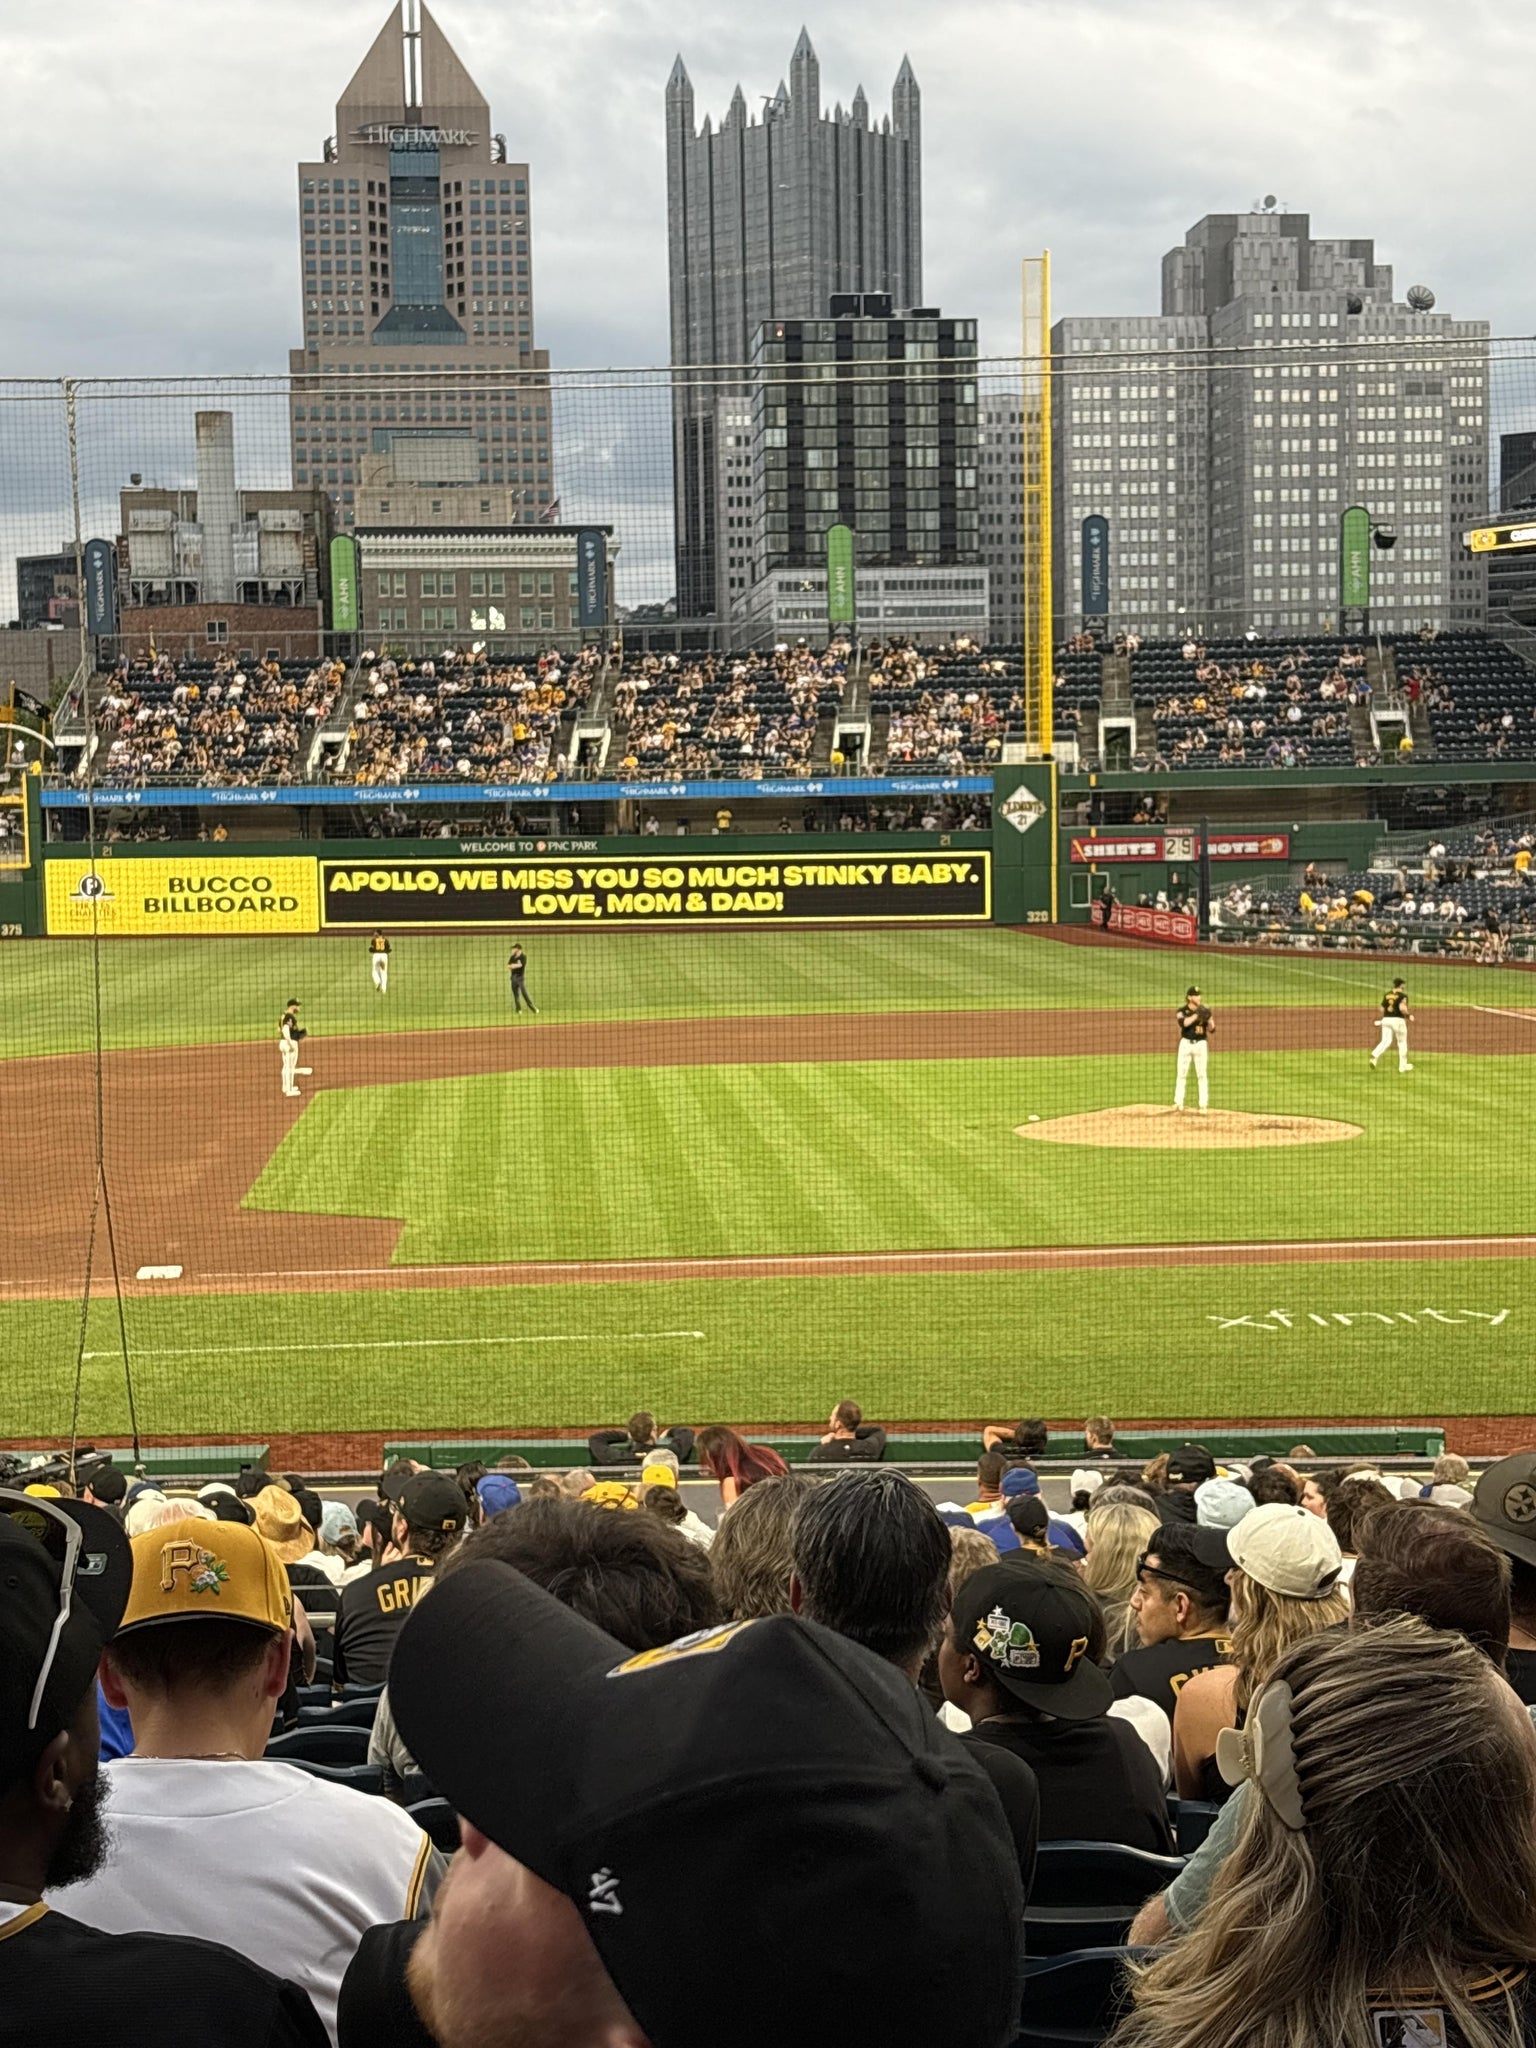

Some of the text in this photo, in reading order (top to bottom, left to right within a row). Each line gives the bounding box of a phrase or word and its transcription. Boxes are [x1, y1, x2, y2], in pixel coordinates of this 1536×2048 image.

[367, 124, 474, 146] HIGHMARK
[1352, 551, 1362, 577] AHN
[836, 566, 846, 592] AHN
[339, 578, 349, 603] AHN
[460, 840, 598, 853] WELCOME TO PNC PARK
[940, 834, 950, 846] 21
[102, 847, 113, 857] 21
[168, 876, 272, 893] BUCCO
[329, 863, 979, 895] APOLLO, WE MISS YOU SO MUCH STINKY BABY.
[144, 896, 299, 913] BILLBOARD
[522, 891, 784, 917] LOVE, MOM & DAD!
[1026, 910, 1049, 923] 320
[1206, 1308, 1511, 1330] xfinity
[160, 1538, 202, 1592] P
[1063, 1635, 1088, 1672] P
